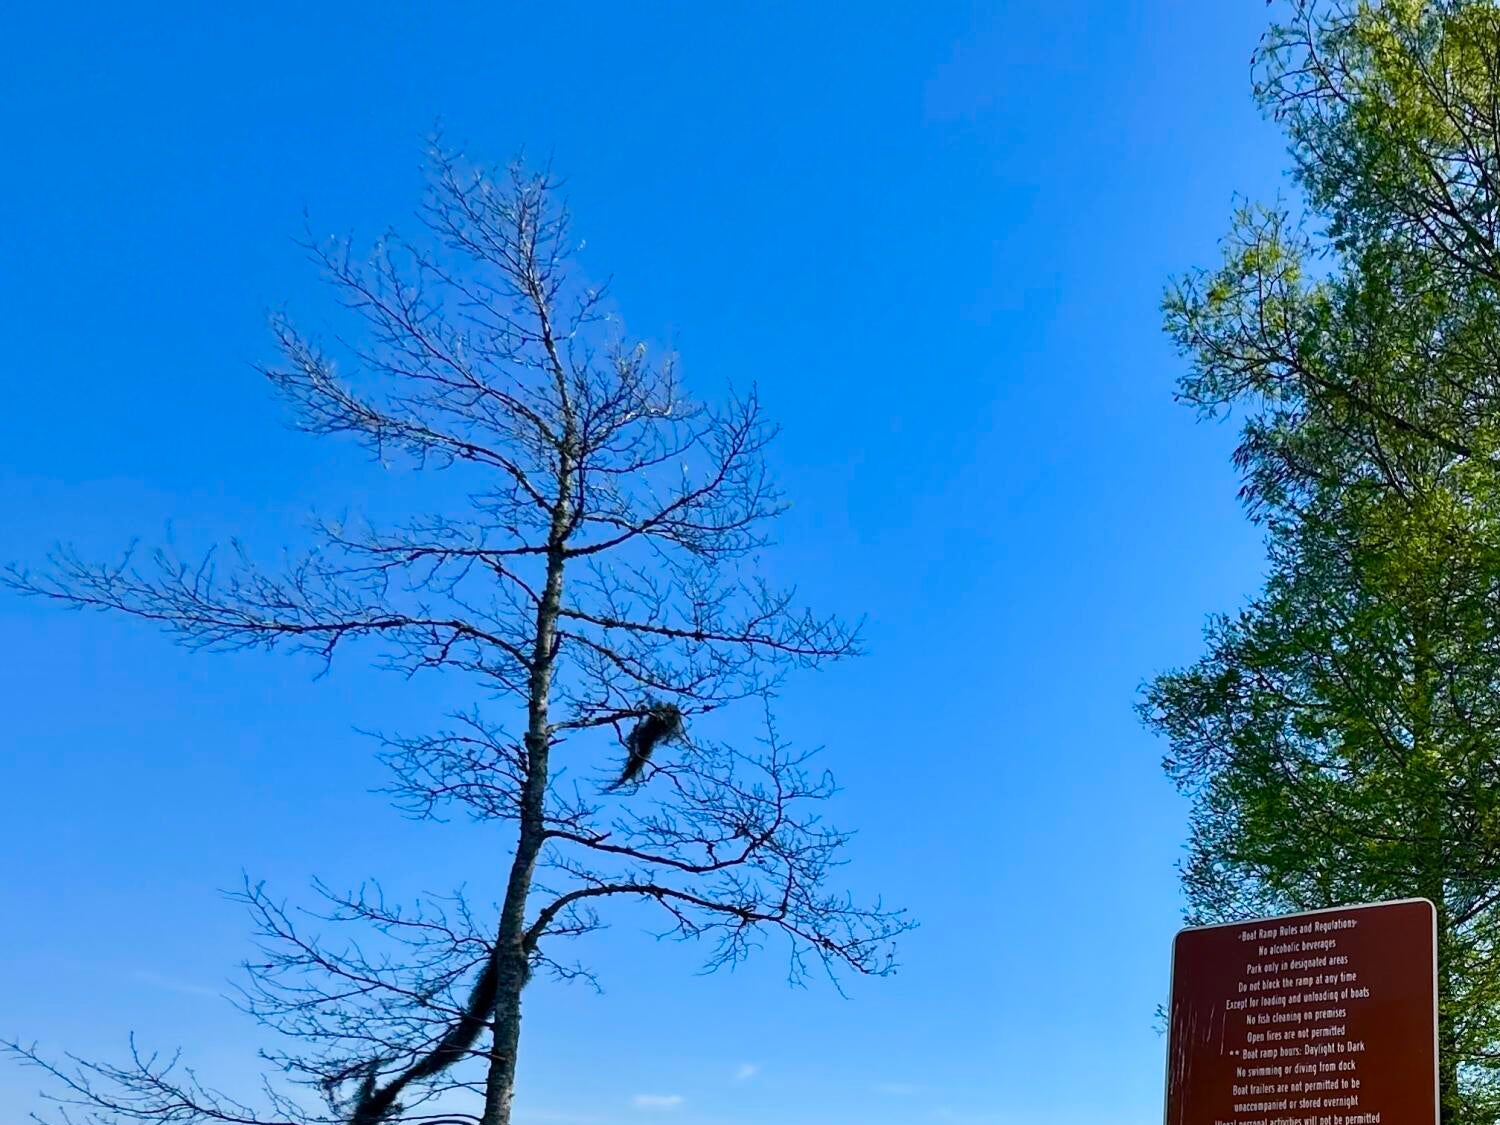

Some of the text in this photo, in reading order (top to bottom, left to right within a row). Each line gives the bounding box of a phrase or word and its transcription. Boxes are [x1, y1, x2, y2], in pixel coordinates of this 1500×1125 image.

[1259, 928, 1277, 940] Ramp
[1280, 925, 1297, 936] Rules
[1300, 923, 1312, 934] and
[1259, 938, 1336, 956] No alcoholic beverages
[1247, 955, 1348, 974] Park only in designated areas
[1239, 971, 1357, 993] Do not block the ramp at any time
[1226, 987, 1370, 1010] Except for loading and unloading of boats
[1247, 1007, 1346, 1025] No fish cleaning on premises
[1247, 1025, 1345, 1044] Open fires are not permitted
[1242, 1049, 1258, 1060] Boat
[1260, 1047, 1277, 1059] ramp
[1304, 1043, 1335, 1056] Daylight
[1337, 1042, 1344, 1052] to
[1347, 1041, 1365, 1051] Dark
[1237, 1059, 1356, 1078] No swimming or diving from dock
[1233, 1077, 1360, 1096] Boat trailers are not permitted to be
[1234, 1095, 1358, 1113] unaccompanied or stored overnight
[1304, 1115, 1317, 1125] will
[1320, 1114, 1332, 1125] not
[1334, 1114, 1343, 1125] be
[1345, 1112, 1380, 1125] permitted
